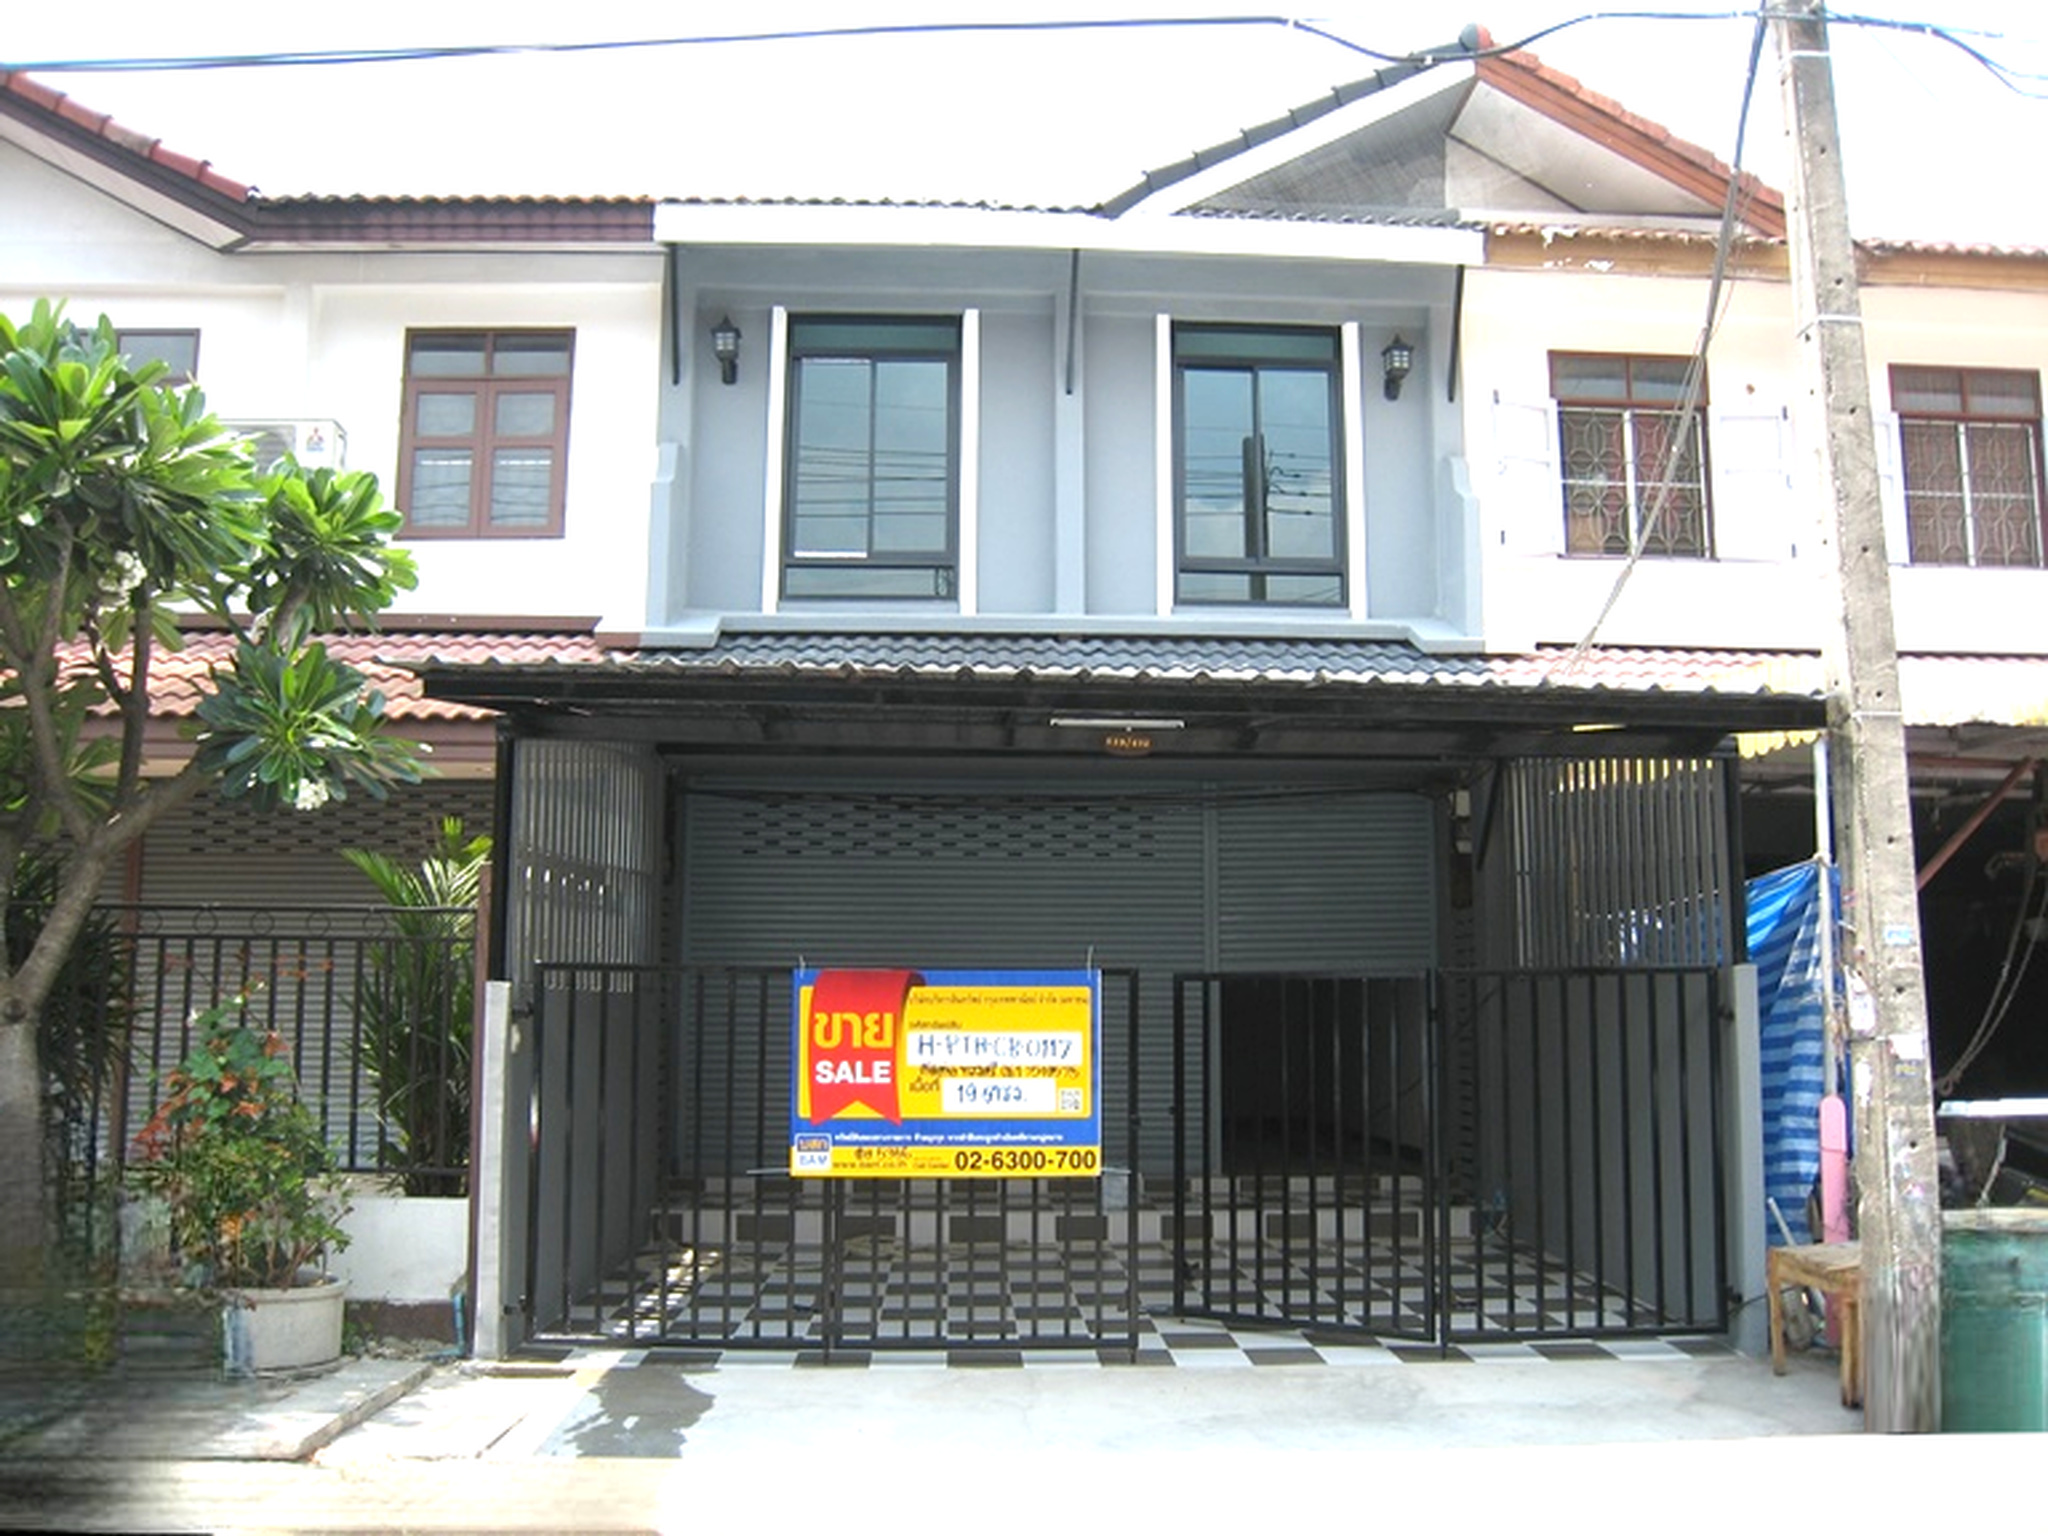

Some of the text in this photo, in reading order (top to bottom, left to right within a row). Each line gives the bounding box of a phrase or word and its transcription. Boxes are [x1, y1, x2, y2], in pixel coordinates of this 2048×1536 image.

[814, 1012, 893, 1048] ขาย
[815, 1060, 891, 1083] SALE
[954, 1150, 1097, 1171] 02-6300-700
